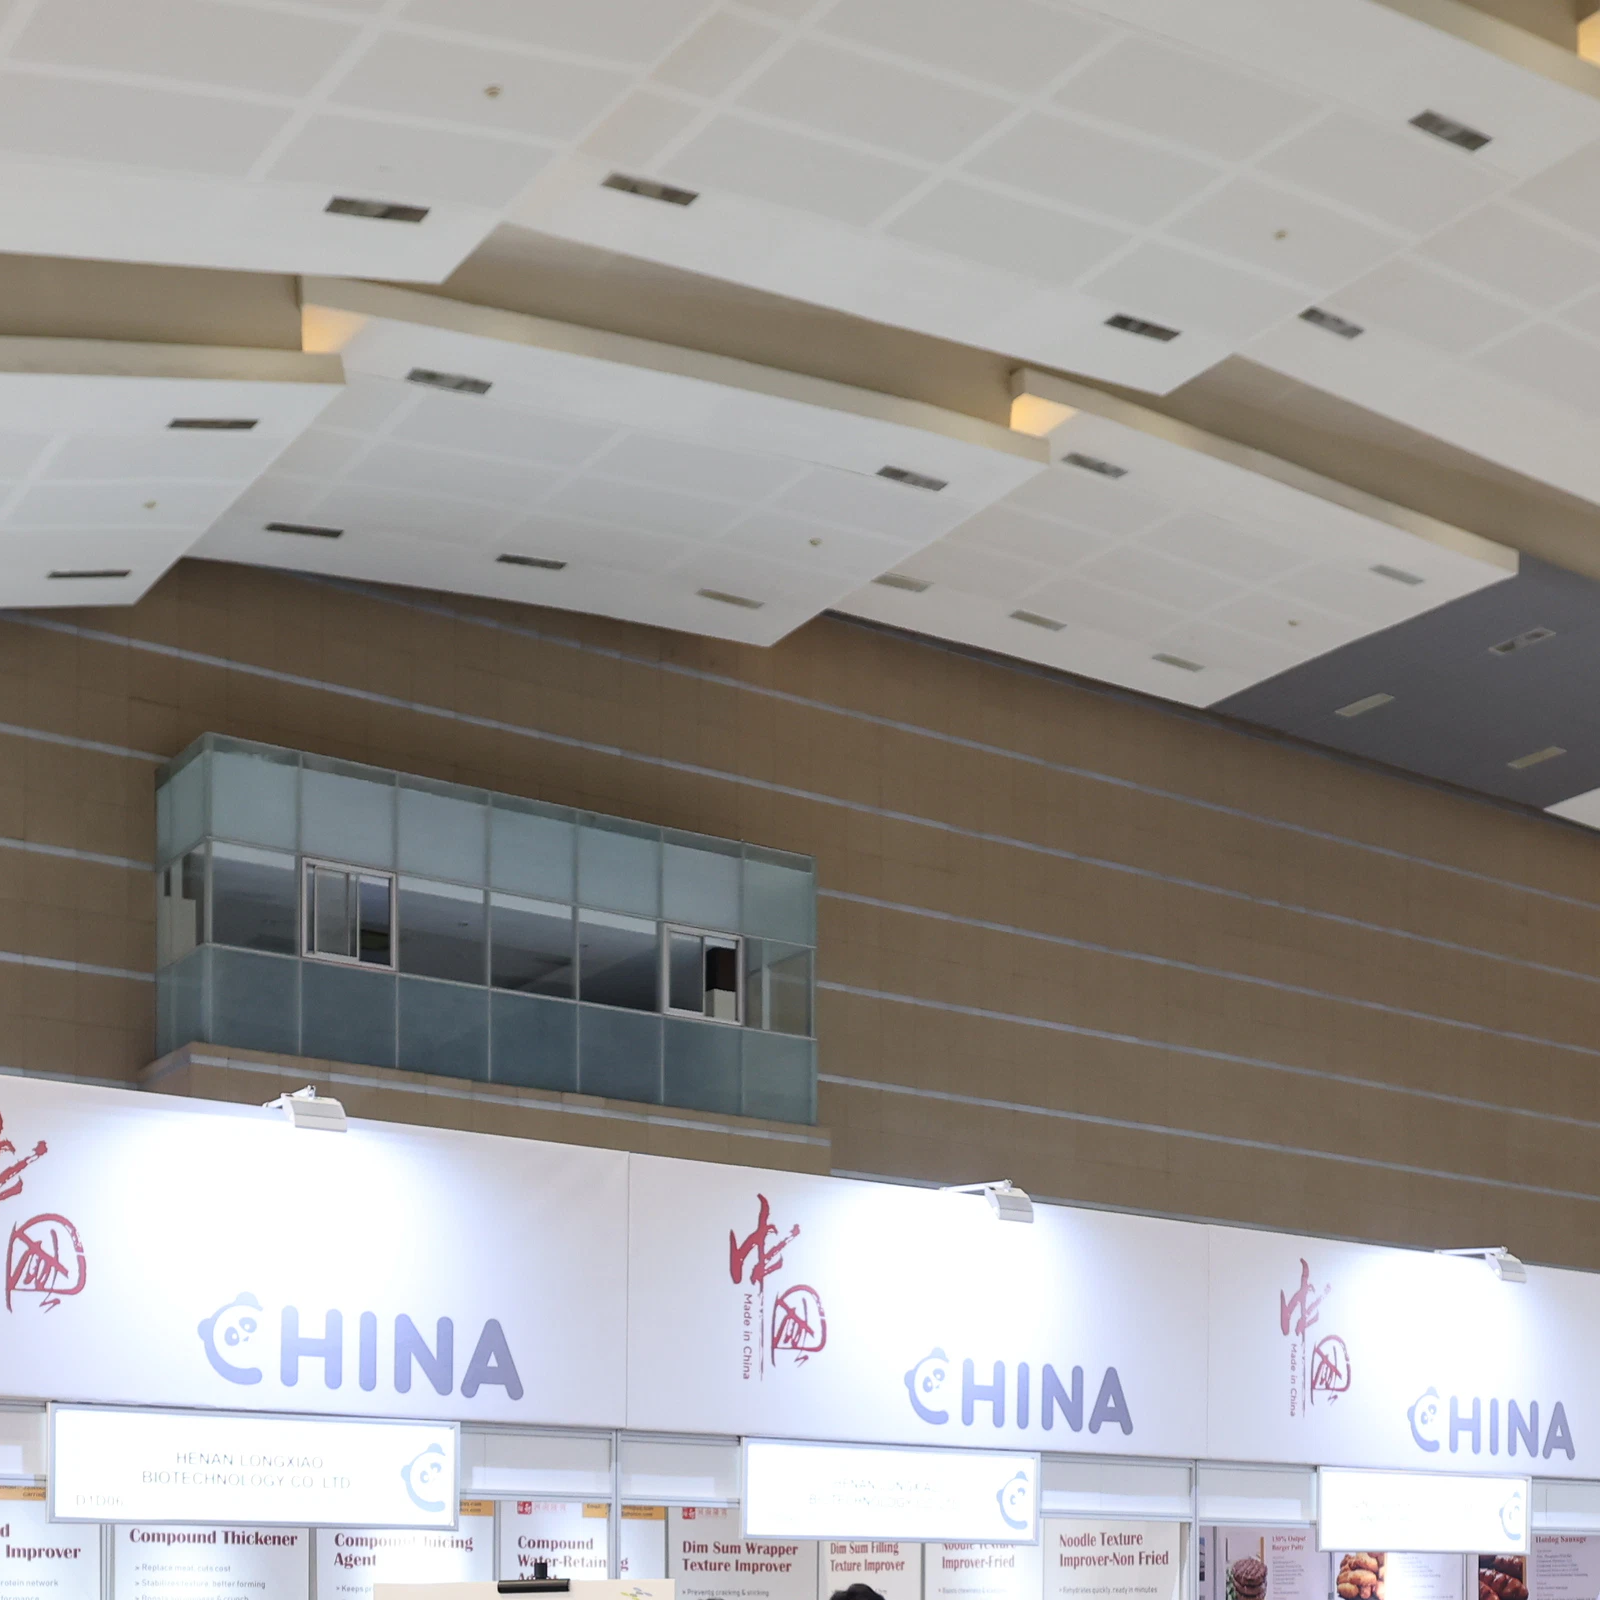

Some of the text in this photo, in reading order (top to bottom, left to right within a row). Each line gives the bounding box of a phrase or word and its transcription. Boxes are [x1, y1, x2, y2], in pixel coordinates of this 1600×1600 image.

[742, 1293, 753, 1380] Made in China
[197, 1291, 524, 1401] CHINA
[904, 1346, 1134, 1436] CHINA
[1289, 1388, 1297, 1417] China
[1407, 1386, 1576, 1461] CHINA
[176, 1452, 324, 1470] HENAN LONGXIAO
[142, 1471, 285, 1488] BIOTECHNOLOGY
[129, 1528, 298, 1547] Compound Thickener
[334, 1533, 474, 1552] Compound Juicing
[518, 1535, 594, 1551] Compound
[1059, 1532, 1143, 1548] Noodle Texture
[5, 1544, 81, 1561] Improver
[682, 1541, 799, 1558] Dim Sum Wrapper
[830, 1542, 899, 1556] Dim Sum Filling
[141, 1563, 172, 1573] Replace
[214, 1564, 231, 1573] cost
[334, 1552, 377, 1568] Agent
[682, 1558, 792, 1574] Texture Improver
[830, 1559, 905, 1575] Texture Improver
[942, 1554, 1015, 1570] Improver-Fried
[1059, 1551, 1169, 1569] Improver-Non Fried
[26, 1579, 59, 1587] network
[212, 1580, 235, 1588] better
[236, 1580, 266, 1589] forming
[341, 1585, 363, 1594] Keeps
[1112, 1587, 1127, 1595] ready
